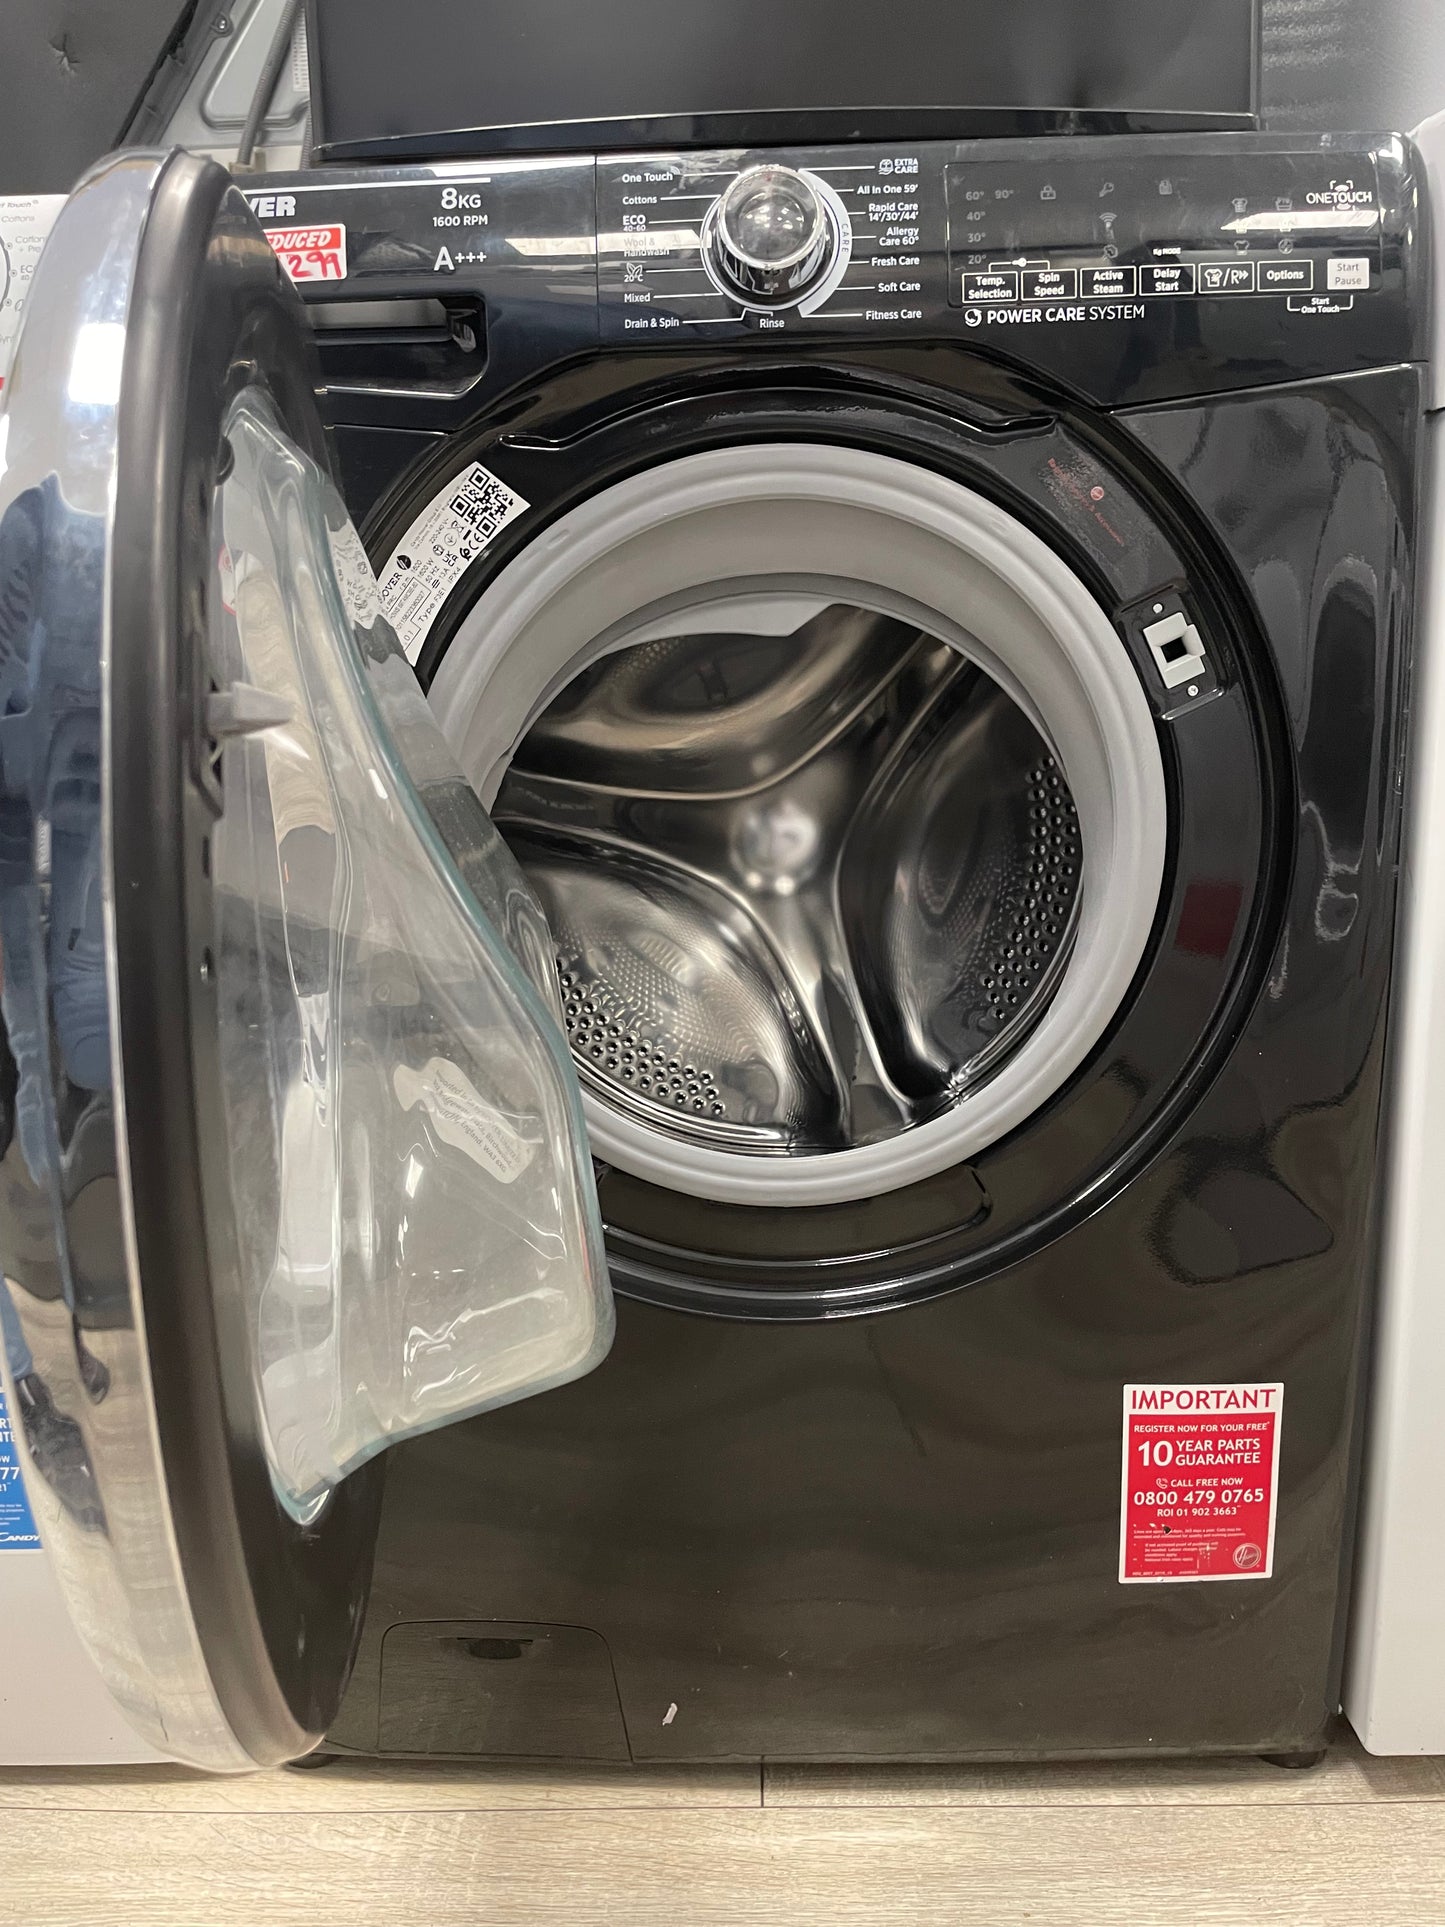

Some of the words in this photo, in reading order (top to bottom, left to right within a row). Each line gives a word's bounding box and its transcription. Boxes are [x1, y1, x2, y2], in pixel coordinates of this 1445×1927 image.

[894, 158, 918, 166] EXTRA
[894, 166, 918, 174] CARE
[622, 174, 642, 183] One
[644, 172, 673, 181] Touch
[857, 185, 870, 194] All
[872, 185, 881, 194] In
[883, 185, 902, 194] One
[622, 196, 657, 205] Cottons
[1306, 191, 1372, 204] ONETOUCH
[250, 195, 296, 218] VER
[868, 202, 896, 212] Rapid
[897, 202, 918, 211] Care
[1, 215, 35, 223] Cottons
[432, 216, 461, 227] 1600
[463, 214, 488, 226] RPM
[622, 214, 646, 225] ECO
[886, 226, 919, 236] Allergy
[266, 230, 332, 250] EDUCED
[623, 236, 647, 247] Wool
[649, 237, 656, 246] &
[841, 223, 849, 252] CARE
[879, 237, 900, 246] Care
[624, 247, 669, 257] Handwash
[433, 246, 487, 271] A+++
[871, 256, 897, 266] Fresh
[898, 256, 920, 265] Care
[1337, 263, 1359, 272] Start
[1038, 272, 1060, 284] Spin
[1093, 271, 1123, 281] Active
[1153, 268, 1181, 279] Delay
[1266, 270, 1304, 281] Options
[878, 281, 897, 292] Soft
[899, 281, 921, 291] Care
[976, 276, 1005, 287] Temp.
[1155, 281, 1179, 292] Start
[1335, 277, 1362, 285] Pause
[968, 289, 1012, 300] Selection
[1034, 285, 1064, 297] Speed
[1093, 284, 1123, 294] Steam
[624, 293, 651, 303] Mixed
[1311, 297, 1330, 305] Start
[865, 310, 898, 320] Fitness
[900, 309, 922, 319] Care
[987, 308, 1042, 324] POWER
[1045, 307, 1086, 322] CARE
[1089, 304, 1145, 320] SYSTEM
[1301, 306, 1316, 314] One
[1318, 305, 1340, 313] Touch
[624, 319, 648, 329] Drain
[650, 319, 658, 328] &
[660, 318, 680, 331] Spin
[759, 318, 785, 328] Rinse
[417, 601, 437, 623] Type
[1131, 1389, 1276, 1410] IMPORTANT
[1134, 1424, 1175, 1433] REGISTER
[1177, 1424, 1198, 1432] NOW
[1200, 1424, 1218, 1432] FOR
[1220, 1423, 1244, 1432] YOUR
[1138, 1440, 1173, 1467] 10
[1175, 1439, 1213, 1452] YEAR
[1218, 1438, 1260, 1450] PARTS
[1175, 1452, 1261, 1466] GUARANTEE
[1170, 1479, 1193, 1487] CALL
[1196, 1478, 1218, 1487] FREE
[1221, 1477, 1243, 1486] NOW
[1134, 1491, 1178, 1506] 0800
[1183, 1490, 1215, 1504] 479
[1221, 1488, 1264, 1503] 0765
[1157, 1508, 1173, 1517] ROI
[1176, 1508, 1188, 1517] 01
[1192, 1507, 1210, 1516] 902
